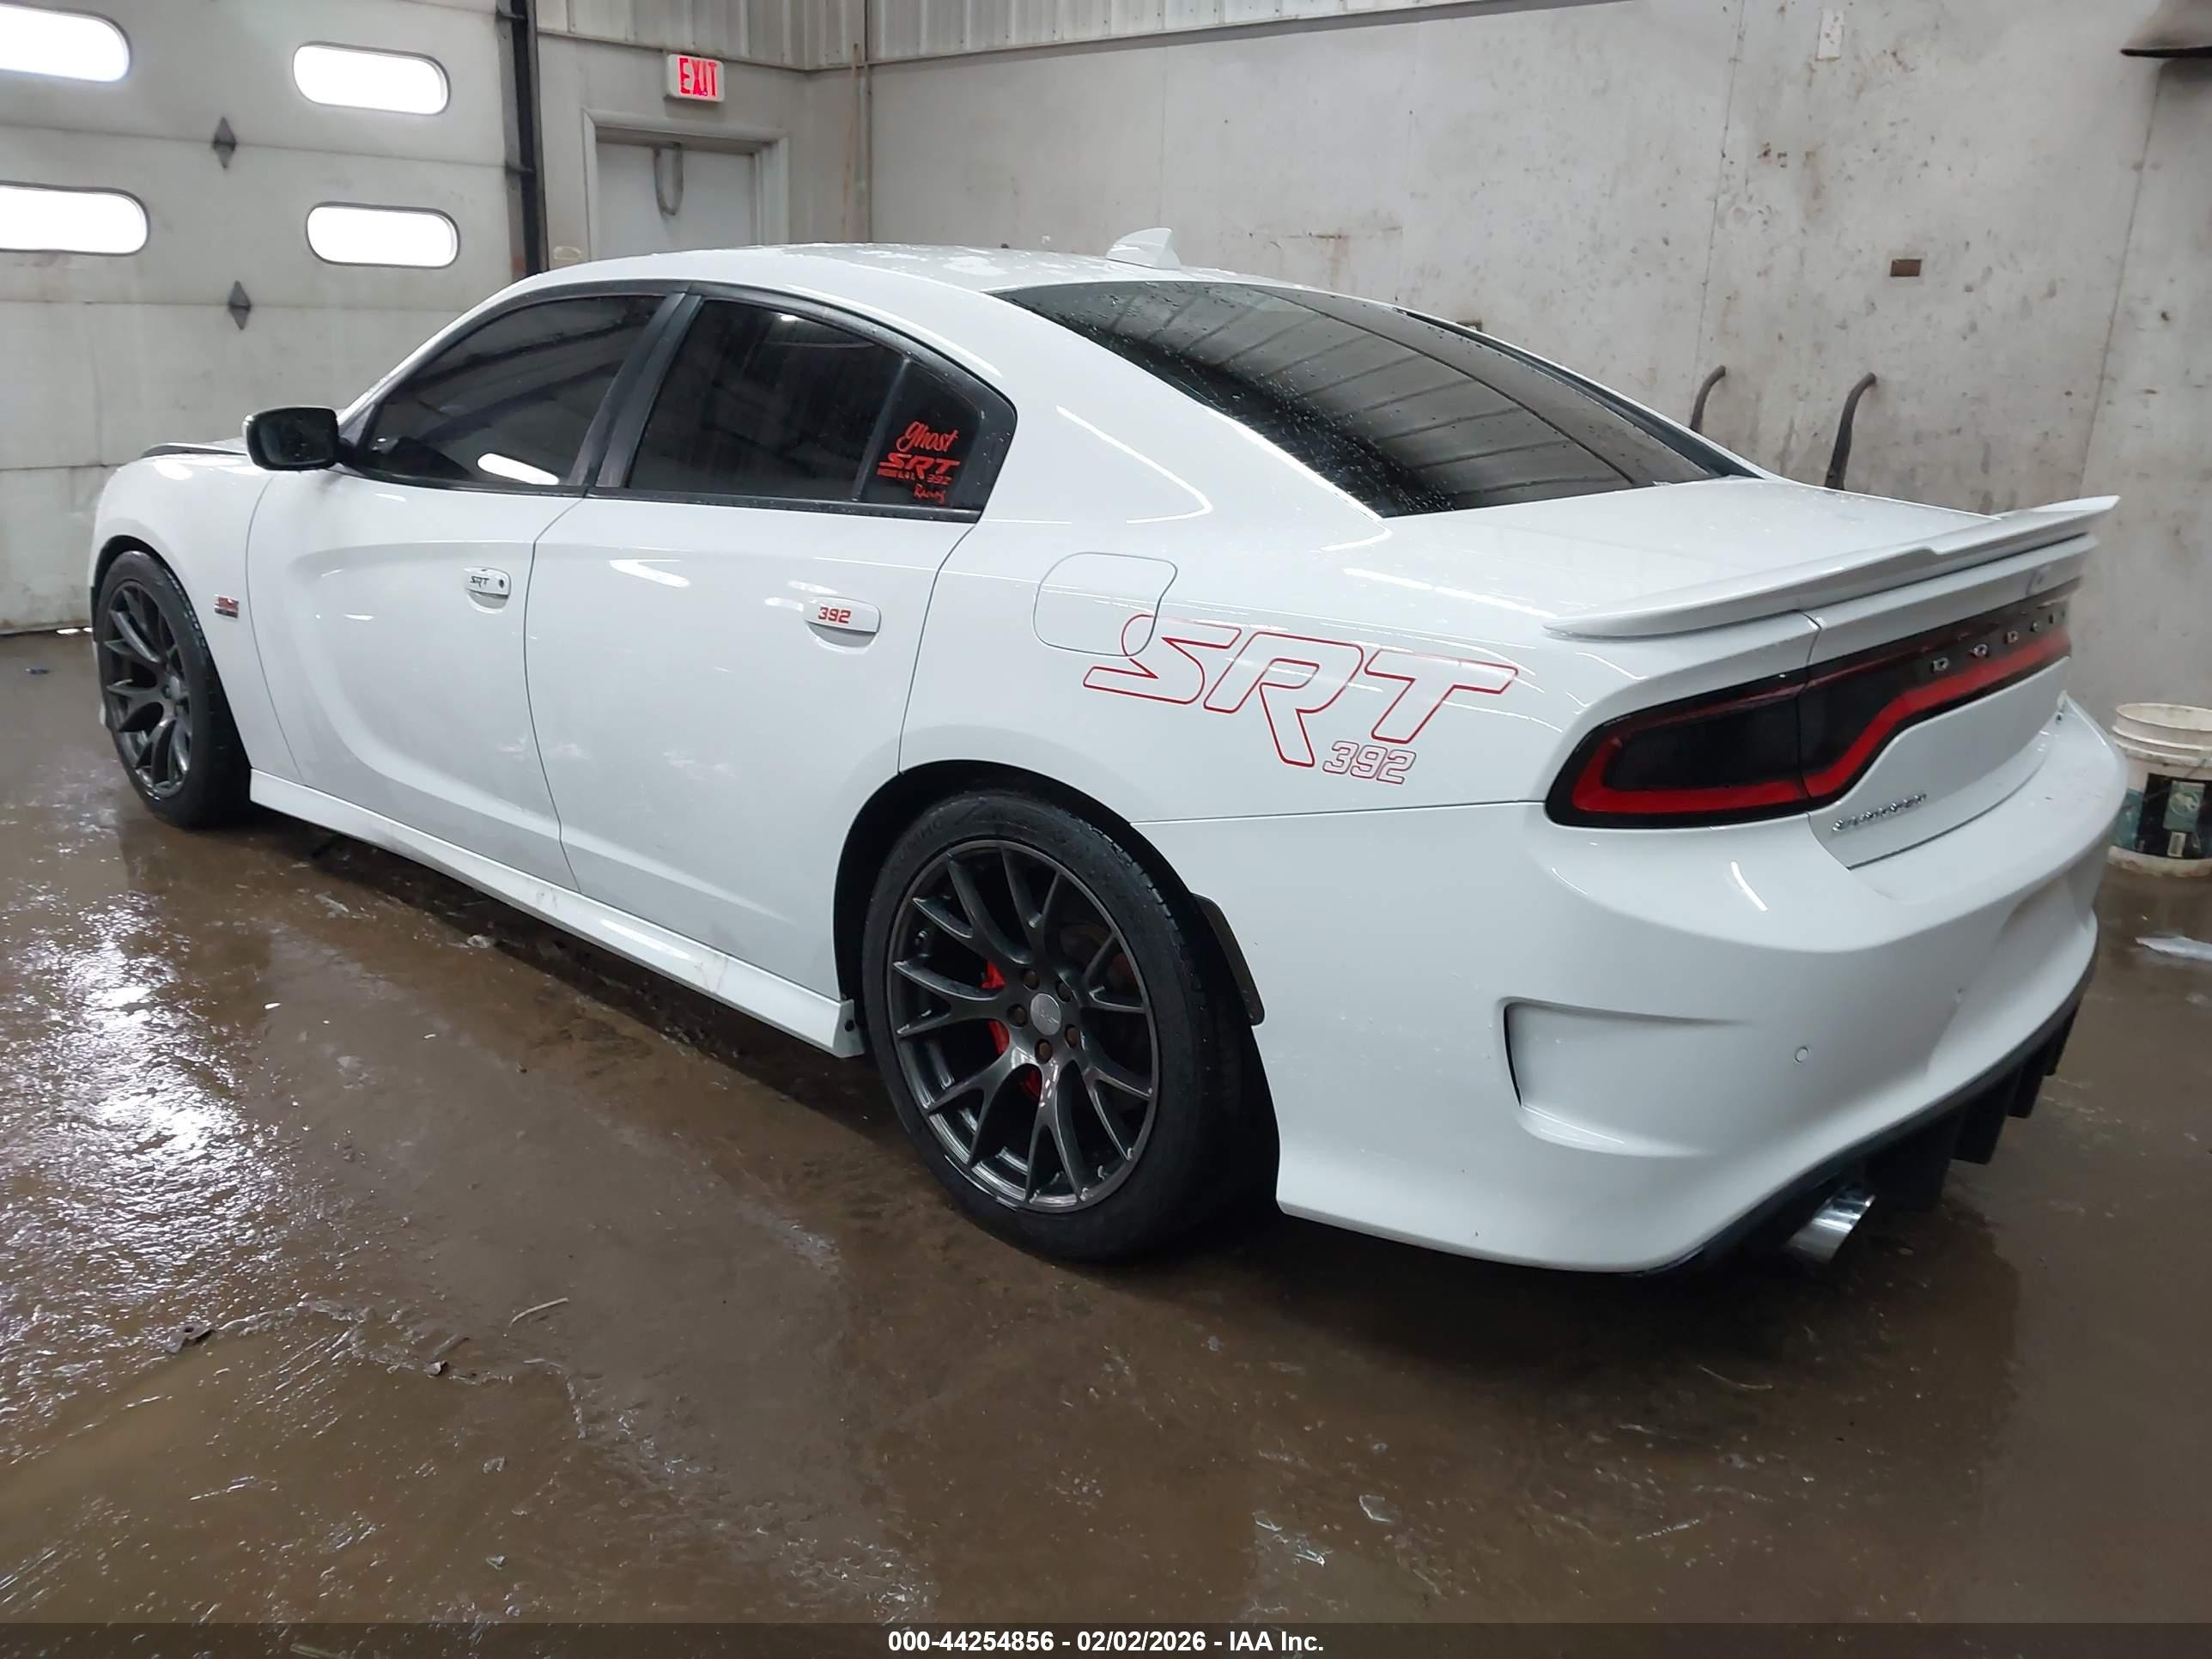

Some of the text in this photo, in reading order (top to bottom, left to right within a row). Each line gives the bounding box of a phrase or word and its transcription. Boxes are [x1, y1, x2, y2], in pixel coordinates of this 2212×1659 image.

[679, 58, 718, 97] EXIT
[878, 453, 961, 480] SRT
[470, 575, 490, 588] SRT
[818, 606, 852, 624] 392
[1083, 613, 1519, 768] SRT
[1322, 740, 1417, 785] 392
